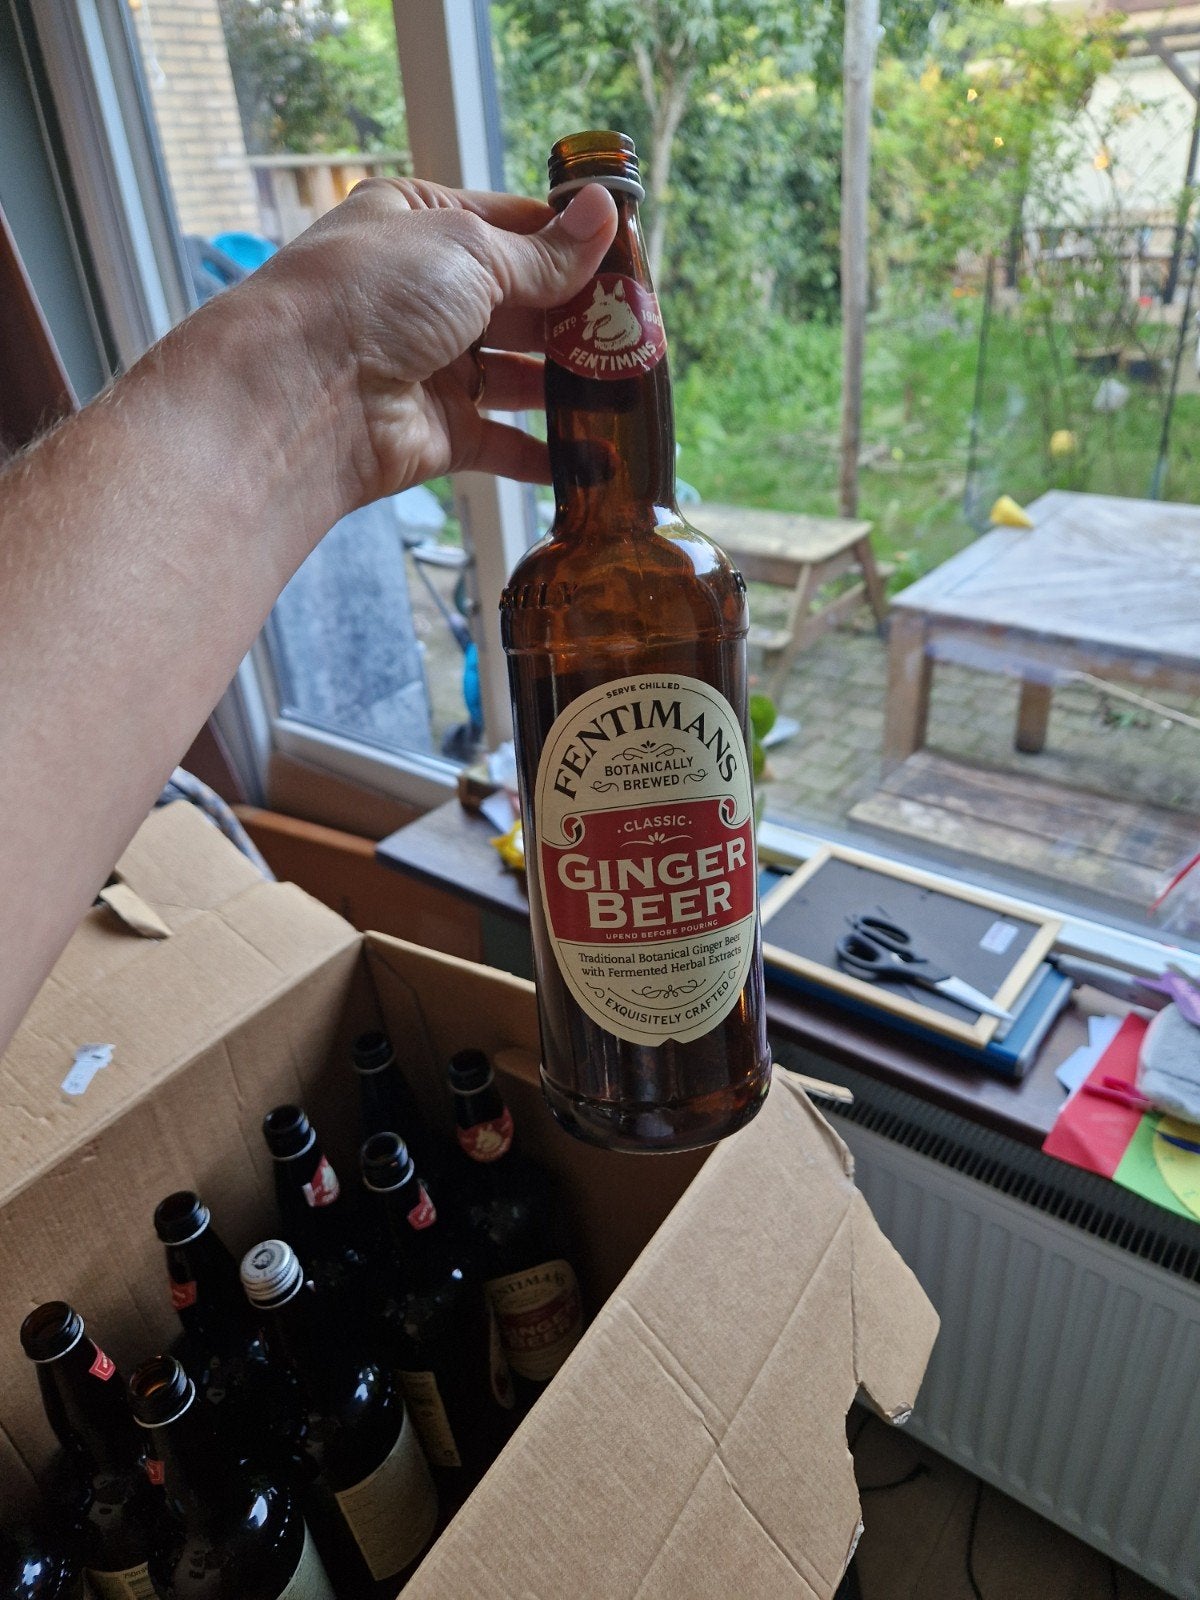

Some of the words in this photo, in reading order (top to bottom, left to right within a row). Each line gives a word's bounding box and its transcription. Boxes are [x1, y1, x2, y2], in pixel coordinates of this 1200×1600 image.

[568, 341, 657, 371] FENTIMANS
[606, 685, 636, 698] SERVE
[639, 682, 680, 691] CHILLED
[554, 699, 738, 801] FENTIMANS
[604, 756, 694, 777] BOTANICALLY
[623, 774, 680, 791] BREWED
[557, 836, 748, 892] GINGER
[586, 880, 734, 930] BEER
[605, 932, 639, 941] UPEND
[641, 928, 679, 939] BEFORE
[681, 919, 719, 933] POURING
[578, 951, 636, 965] Traditional
[638, 946, 691, 964] Botanical
[692, 938, 724, 956] Ginger
[724, 931, 742, 947] Beer
[581, 966, 606, 978] with
[608, 966, 669, 978] Fermented
[671, 957, 707, 974] Herbal
[708, 945, 743, 965] Extracts
[605, 998, 683, 1025] EXQUISITELY
[685, 981, 730, 1019] CRAFTED
